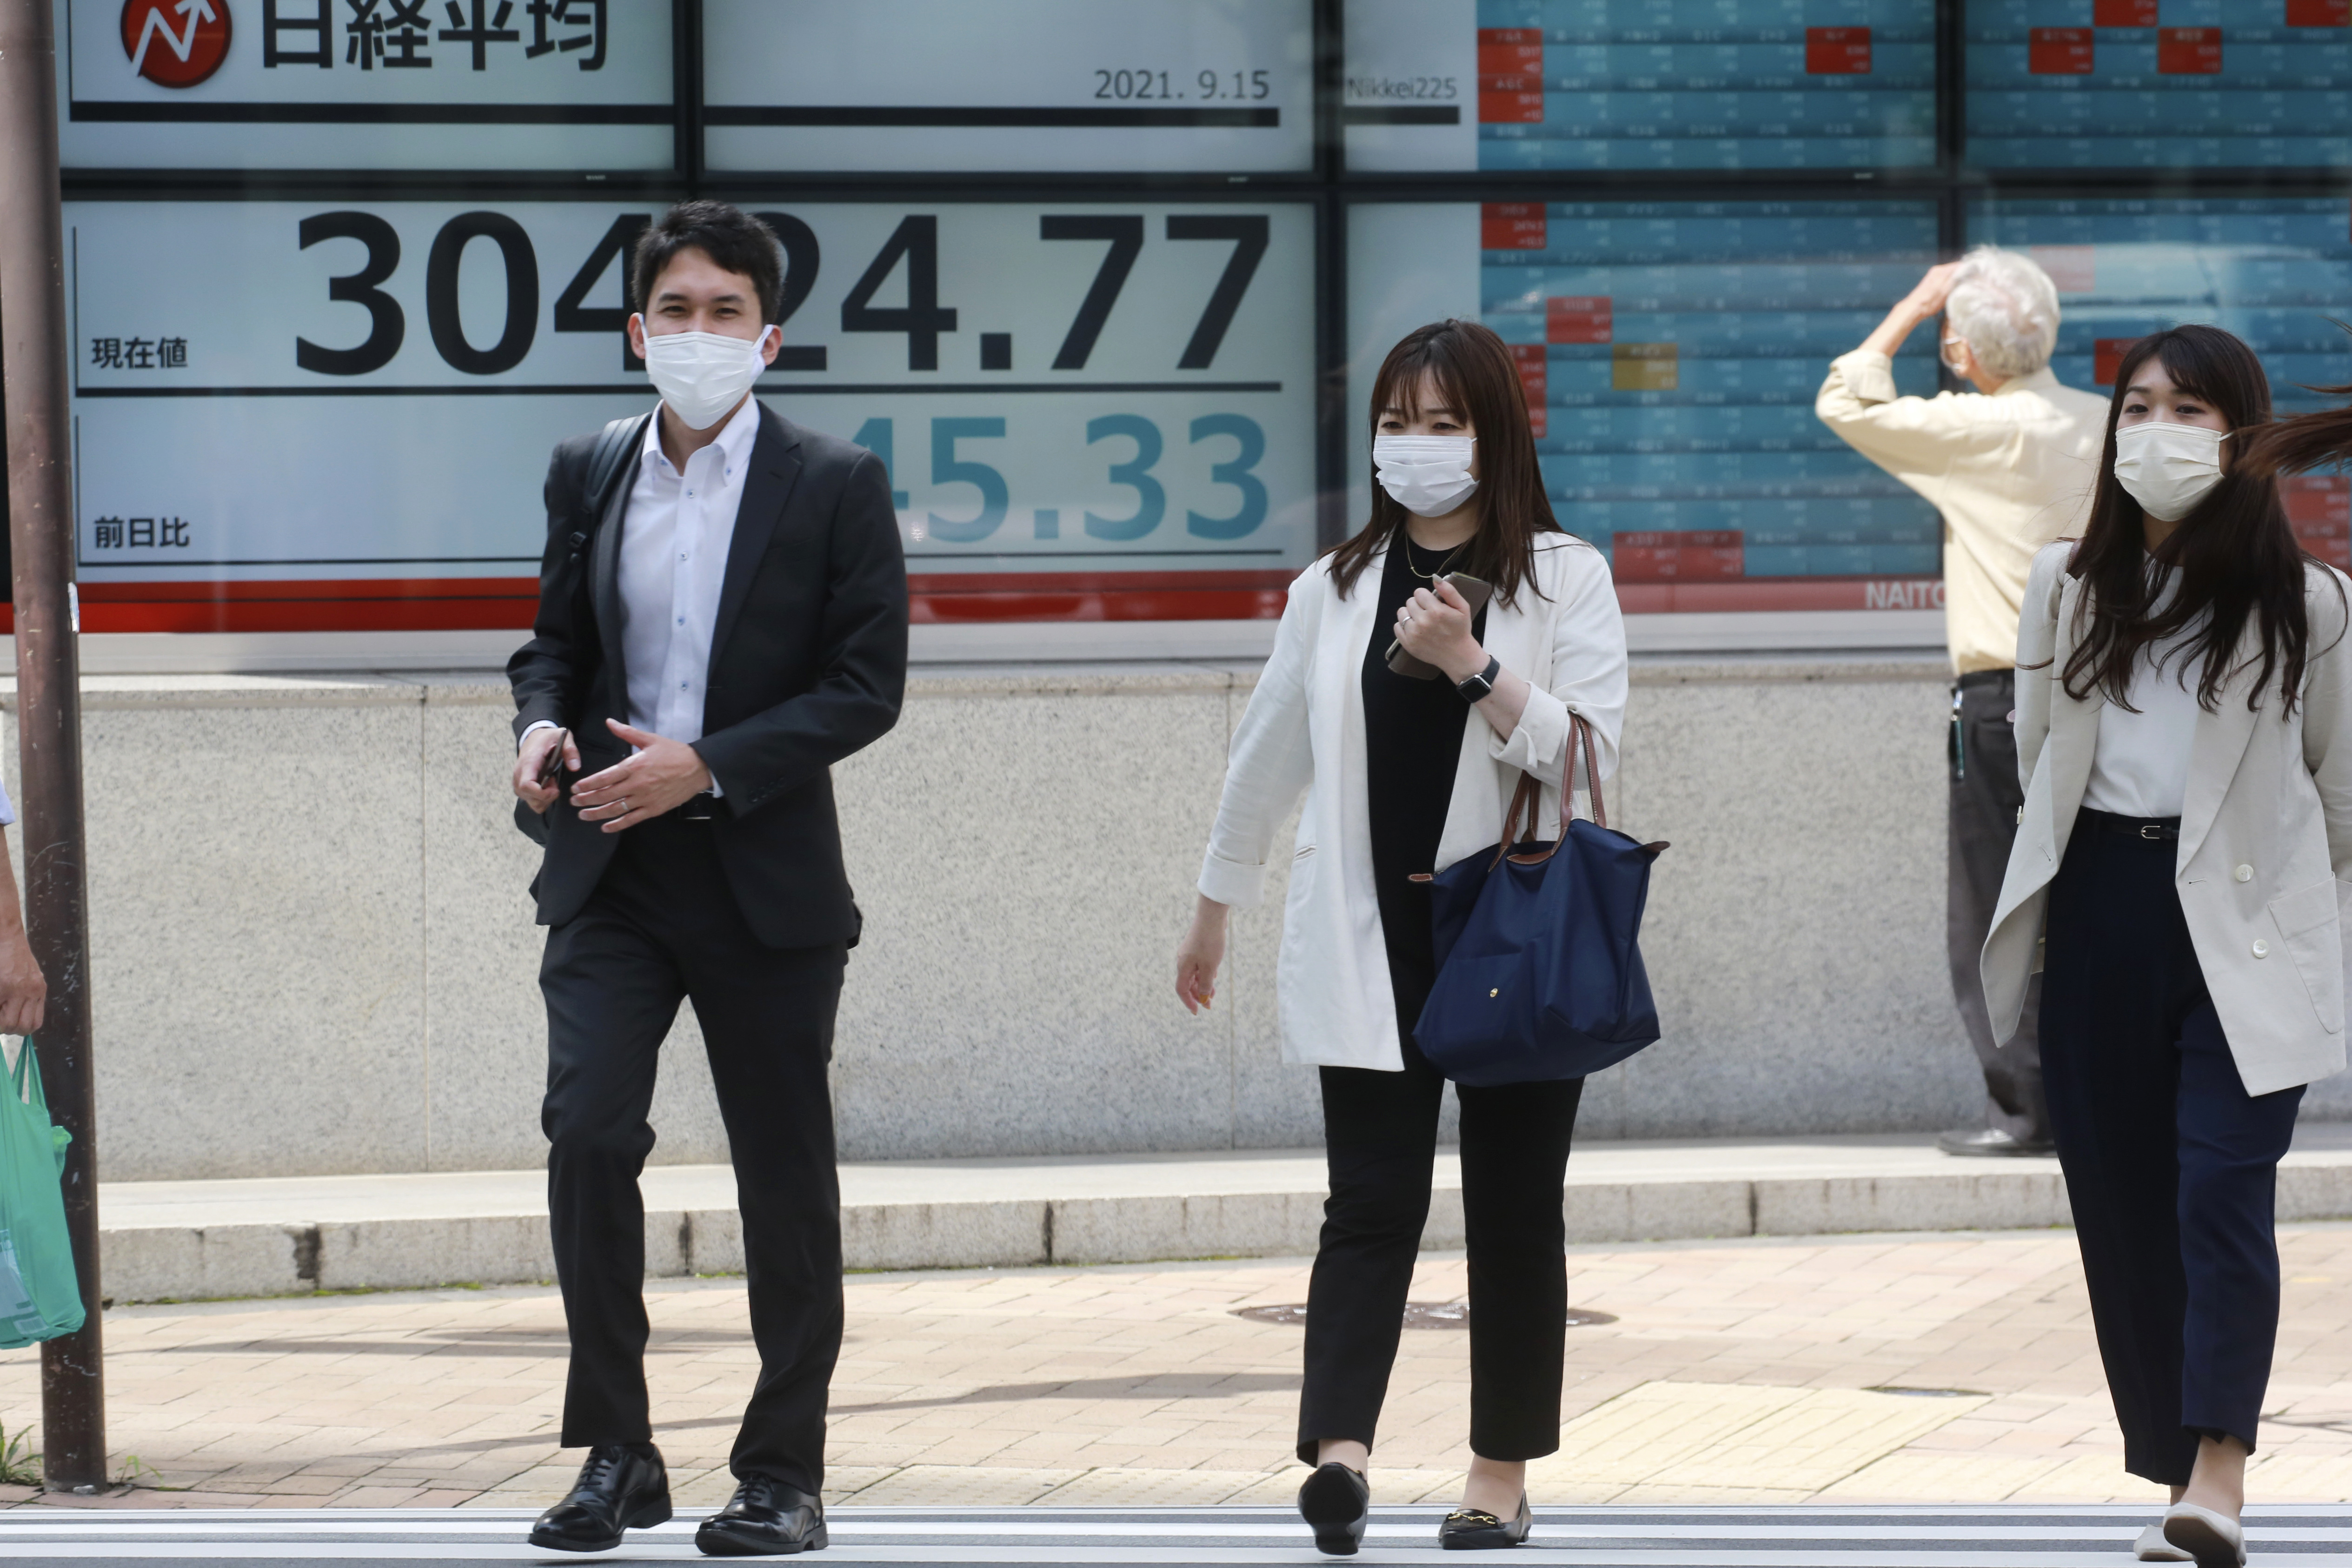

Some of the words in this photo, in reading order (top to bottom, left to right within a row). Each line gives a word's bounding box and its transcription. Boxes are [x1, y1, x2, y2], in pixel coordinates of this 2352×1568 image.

[263, 0, 607, 71] 日経平均
[1198, 69, 1270, 100] 9.15
[1347, 76, 1457, 99] Nikkei225
[92, 336, 188, 369] 現在値
[93, 516, 190, 549] 前日比
